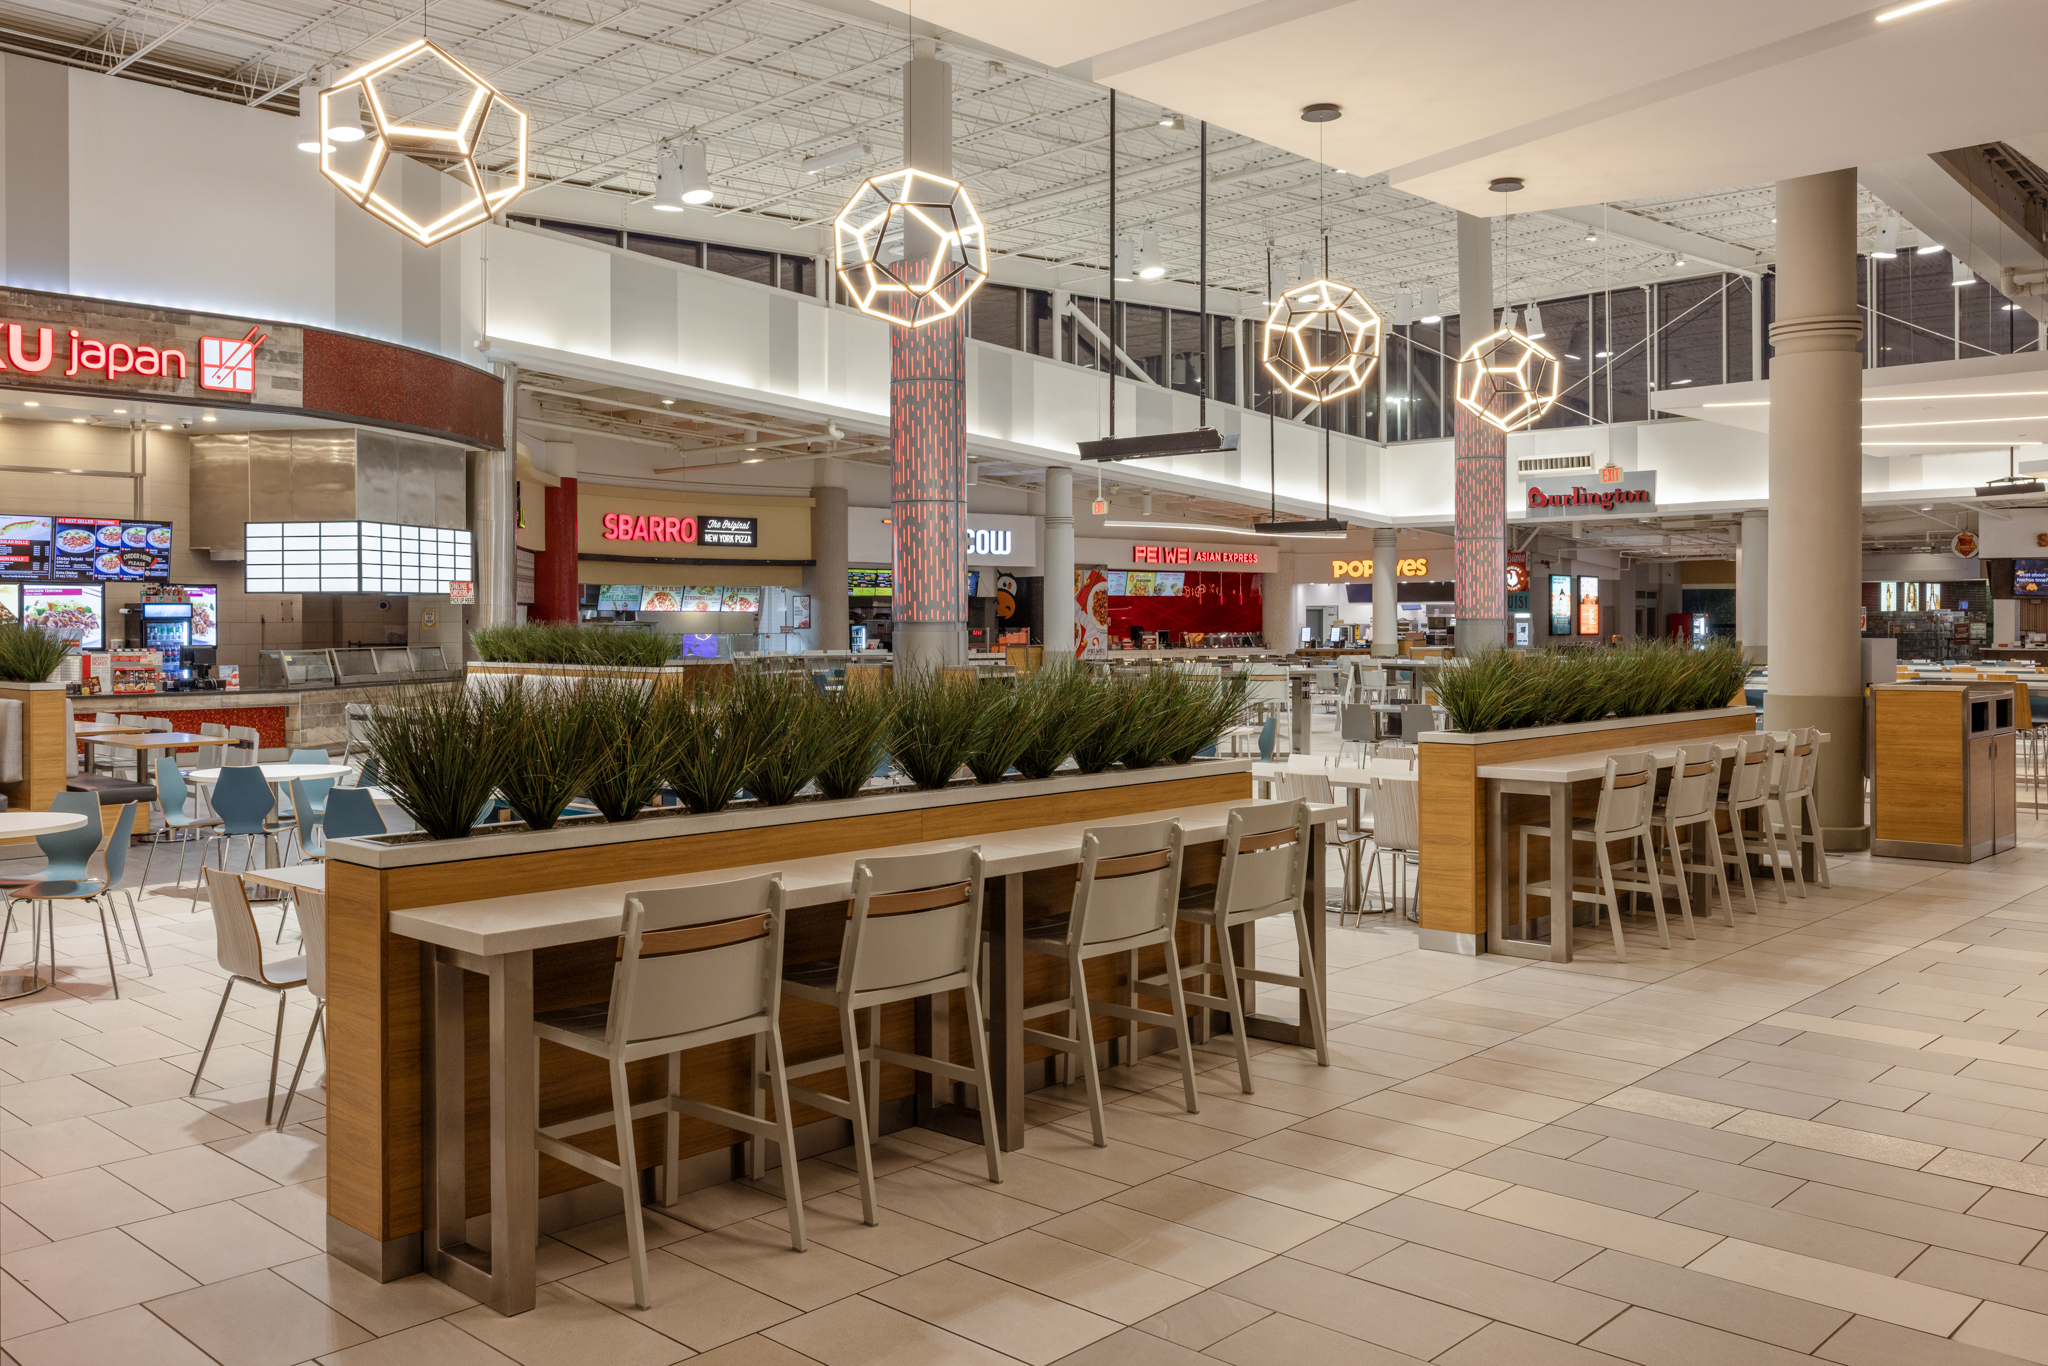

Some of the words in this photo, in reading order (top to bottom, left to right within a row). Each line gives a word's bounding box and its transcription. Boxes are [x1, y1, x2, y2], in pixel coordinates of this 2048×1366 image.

[65, 329, 187, 380] japan
[1602, 467, 1620, 482] EXIT
[1528, 486, 1650, 511] Burlington
[1094, 502, 1105, 514] EXIT
[603, 513, 697, 543] SBARRO
[707, 519, 721, 529] The
[721, 519, 751, 531] Original
[704, 533, 718, 543] NEW
[719, 534, 734, 543] YORK
[735, 534, 752, 544] PIZZA
[967, 529, 1012, 555] COW
[140, 554, 152, 563] HERE
[1133, 546, 1162, 563] PEI
[1163, 547, 1192, 564] WEI
[1195, 552, 1221, 562] ASIAN
[1222, 552, 1258, 563] EXPRESS
